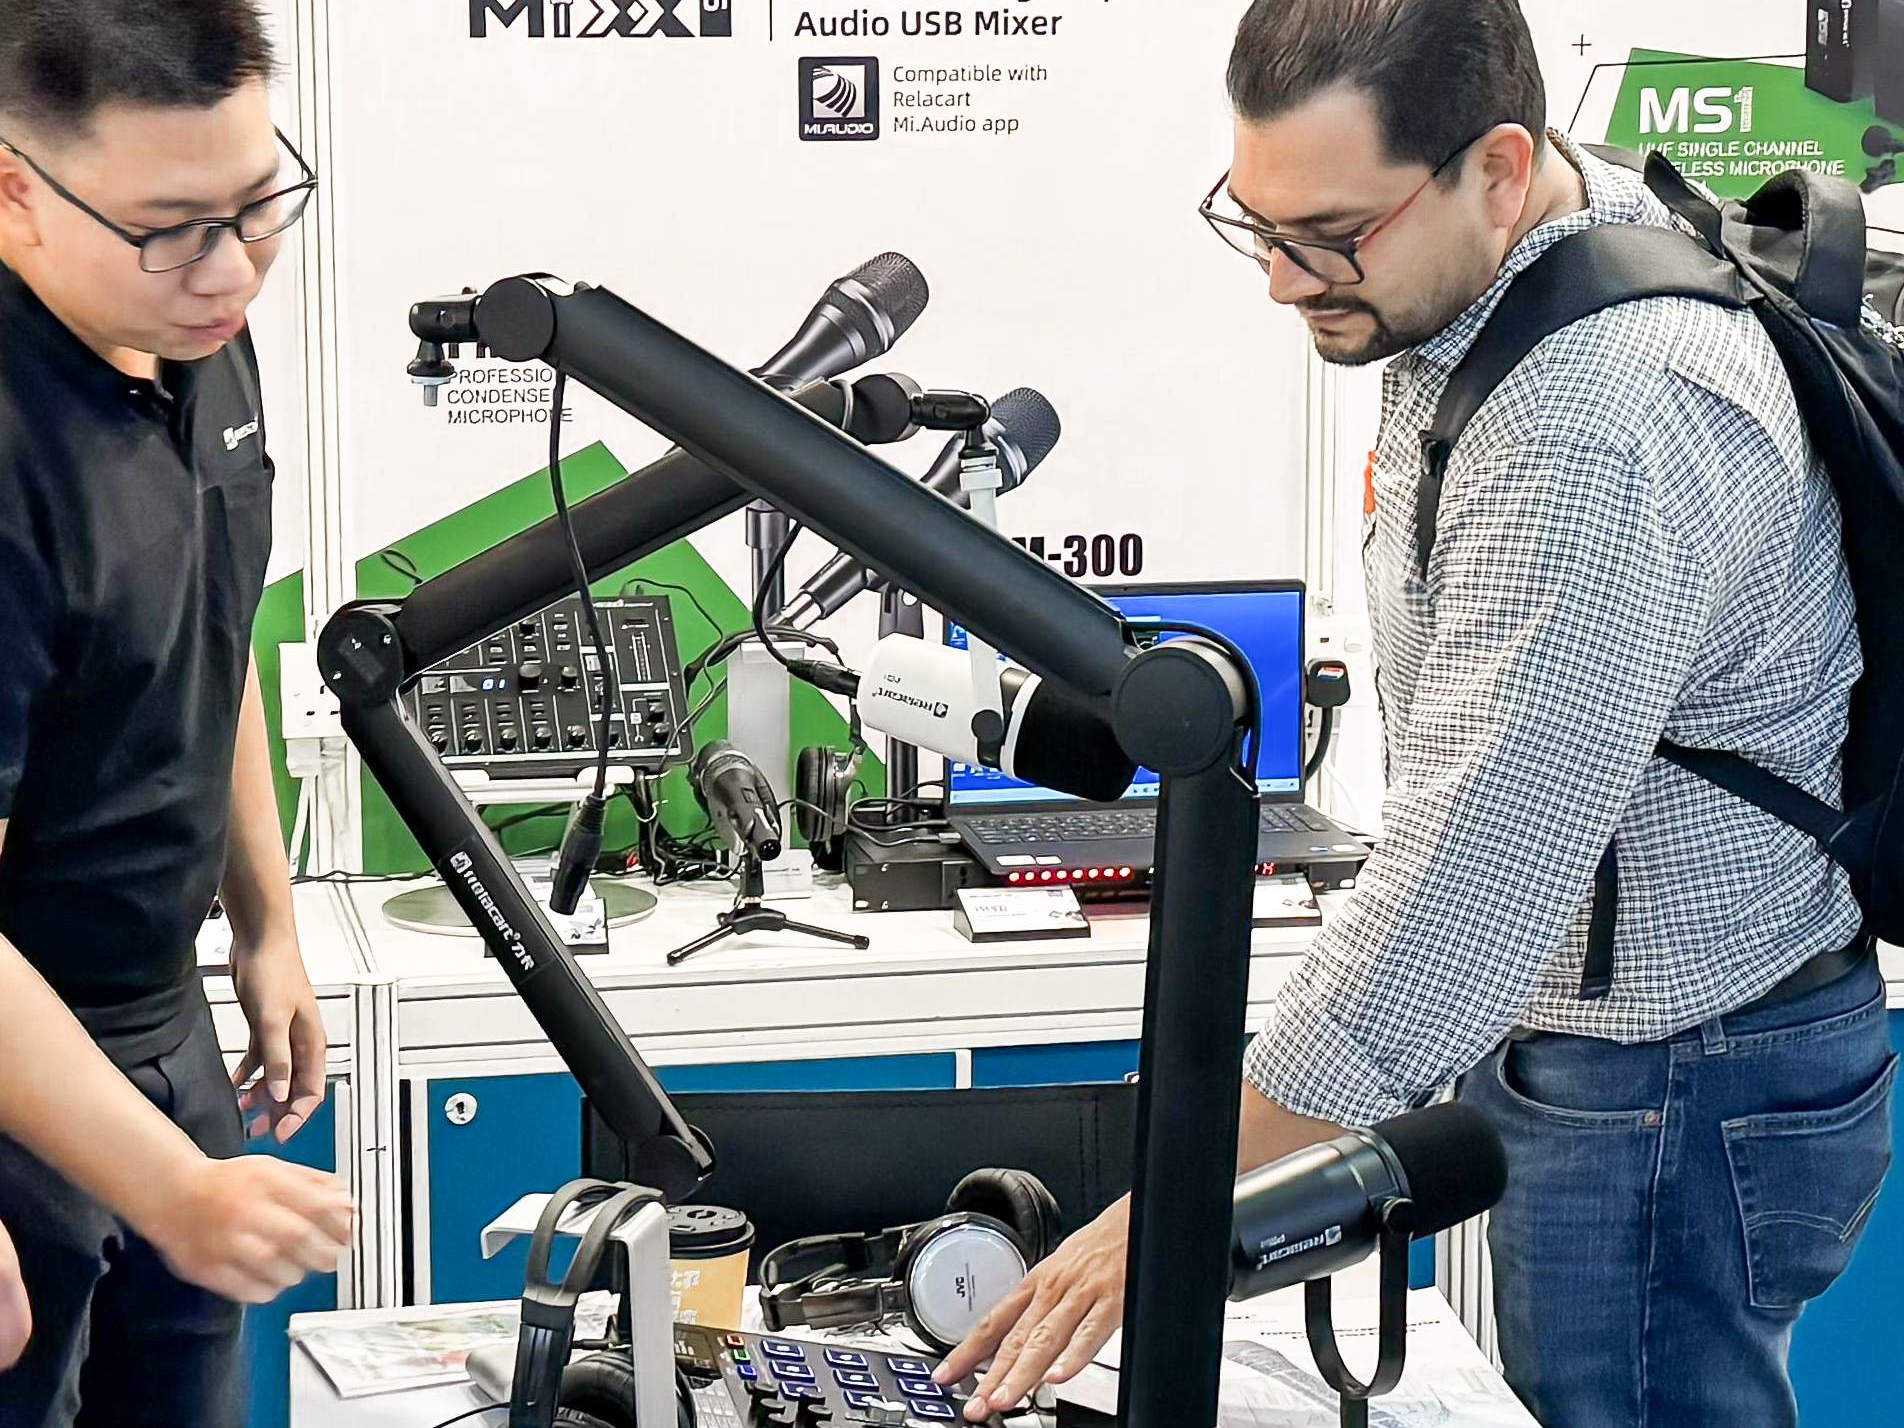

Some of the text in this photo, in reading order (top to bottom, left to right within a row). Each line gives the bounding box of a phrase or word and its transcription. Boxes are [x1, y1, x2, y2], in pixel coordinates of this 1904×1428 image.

[793, 8, 1063, 37] Audio USB Mixer
[893, 64, 1048, 85] Compatible with
[893, 90, 971, 108] Relacart
[1639, 86, 1753, 134] MS1
[893, 115, 1019, 136] Mi.Audio app
[1677, 141, 1740, 158] SINGLE
[1743, 140, 1824, 157] CHANNEL
[1673, 159, 1845, 177] ELESS MICROPHONE
[451, 368, 553, 385] PROFESSIO
[447, 387, 551, 405] CONDENSE
[955, 1276, 966, 1299] JVC
